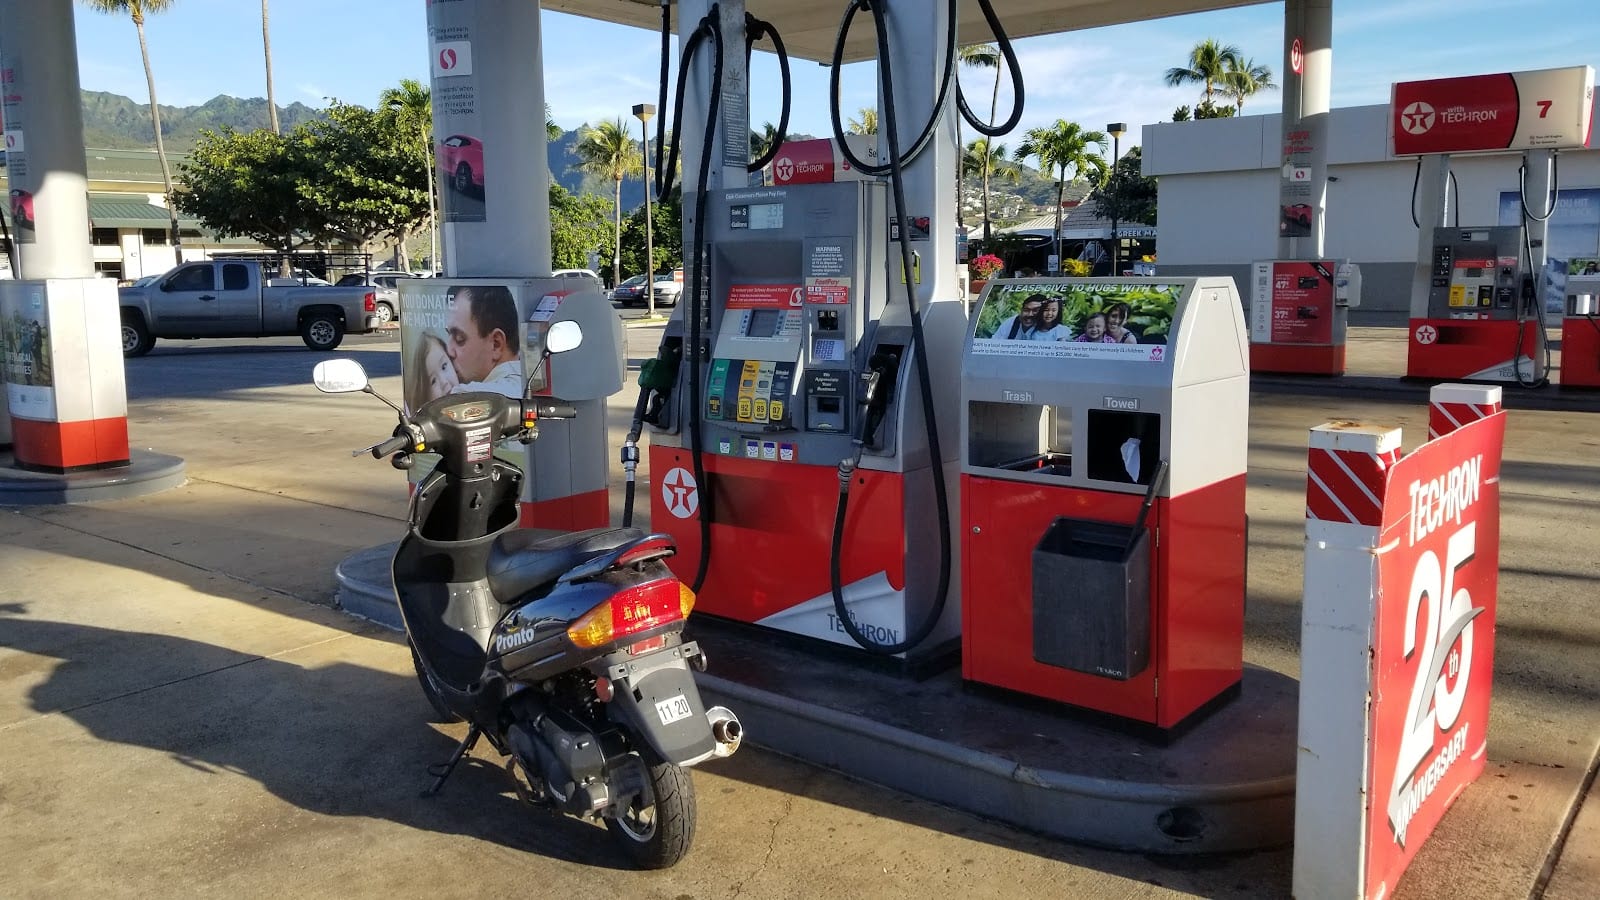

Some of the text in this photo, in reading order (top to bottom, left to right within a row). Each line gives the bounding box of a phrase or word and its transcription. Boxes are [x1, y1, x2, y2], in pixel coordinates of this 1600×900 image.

[1440, 110, 1498, 124] TECHRON
[1536, 100, 1552, 118] 7
[796, 164, 824, 174] TECHRON
[402, 294, 414, 308] YOU
[402, 312, 413, 327] WE
[1003, 391, 1032, 402] Trash
[1105, 397, 1138, 410] Towel
[1408, 454, 1483, 548] TECHRON
[827, 613, 898, 644] TEHRON
[496, 628, 534, 652] Pronto
[1398, 520, 1476, 796] 25
[1449, 648, 1459, 679] th
[659, 699, 688, 720] 11 20
[1394, 722, 1470, 846] ANNIVERSARY
